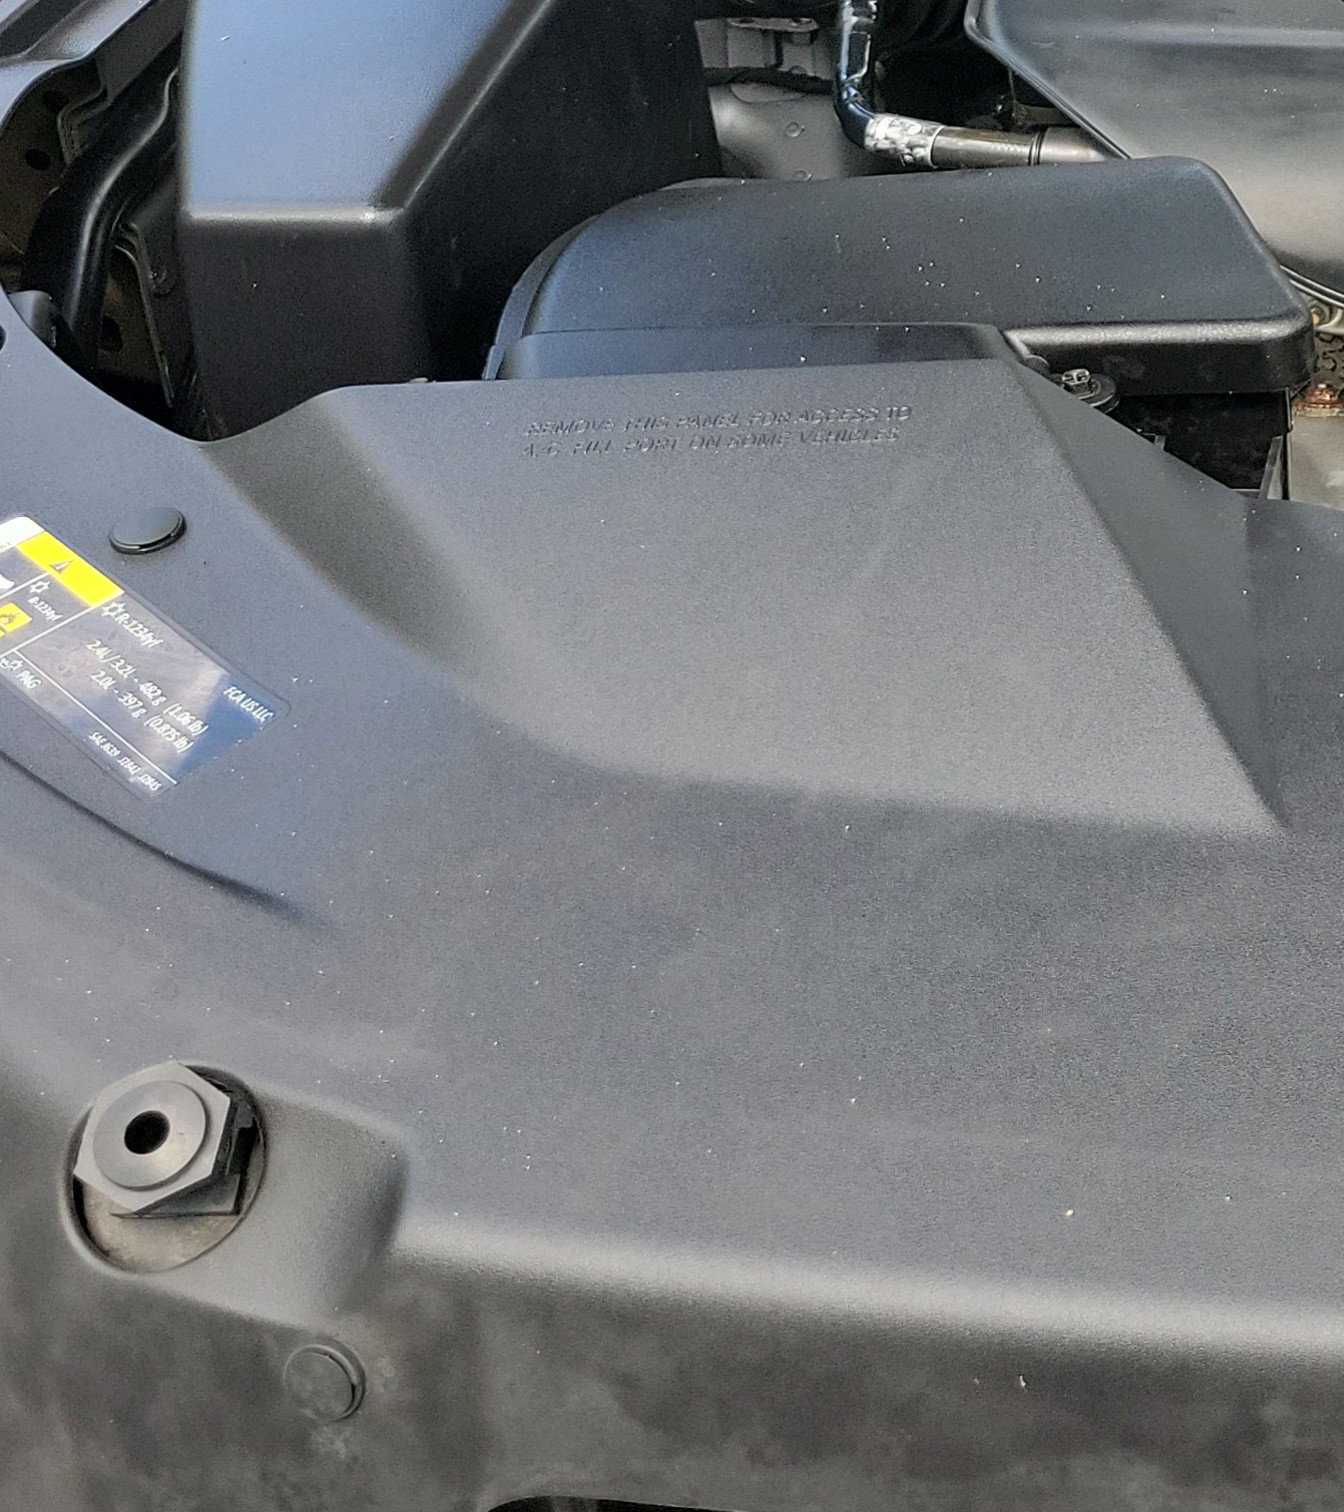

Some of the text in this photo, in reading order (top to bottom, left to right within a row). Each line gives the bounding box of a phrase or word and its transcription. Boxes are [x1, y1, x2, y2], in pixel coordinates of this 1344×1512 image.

[524, 405, 912, 437] REMOVE THIS PANEL FOR ACCESS TO
[572, 439, 613, 455] FILL
[622, 437, 678, 453] PORT
[689, 435, 721, 452] ON
[726, 431, 791, 449] SOME
[799, 428, 900, 447] VEHICLES
[114, 611, 164, 648] R-1234yf
[223, 686, 274, 723] FCA US LLC
